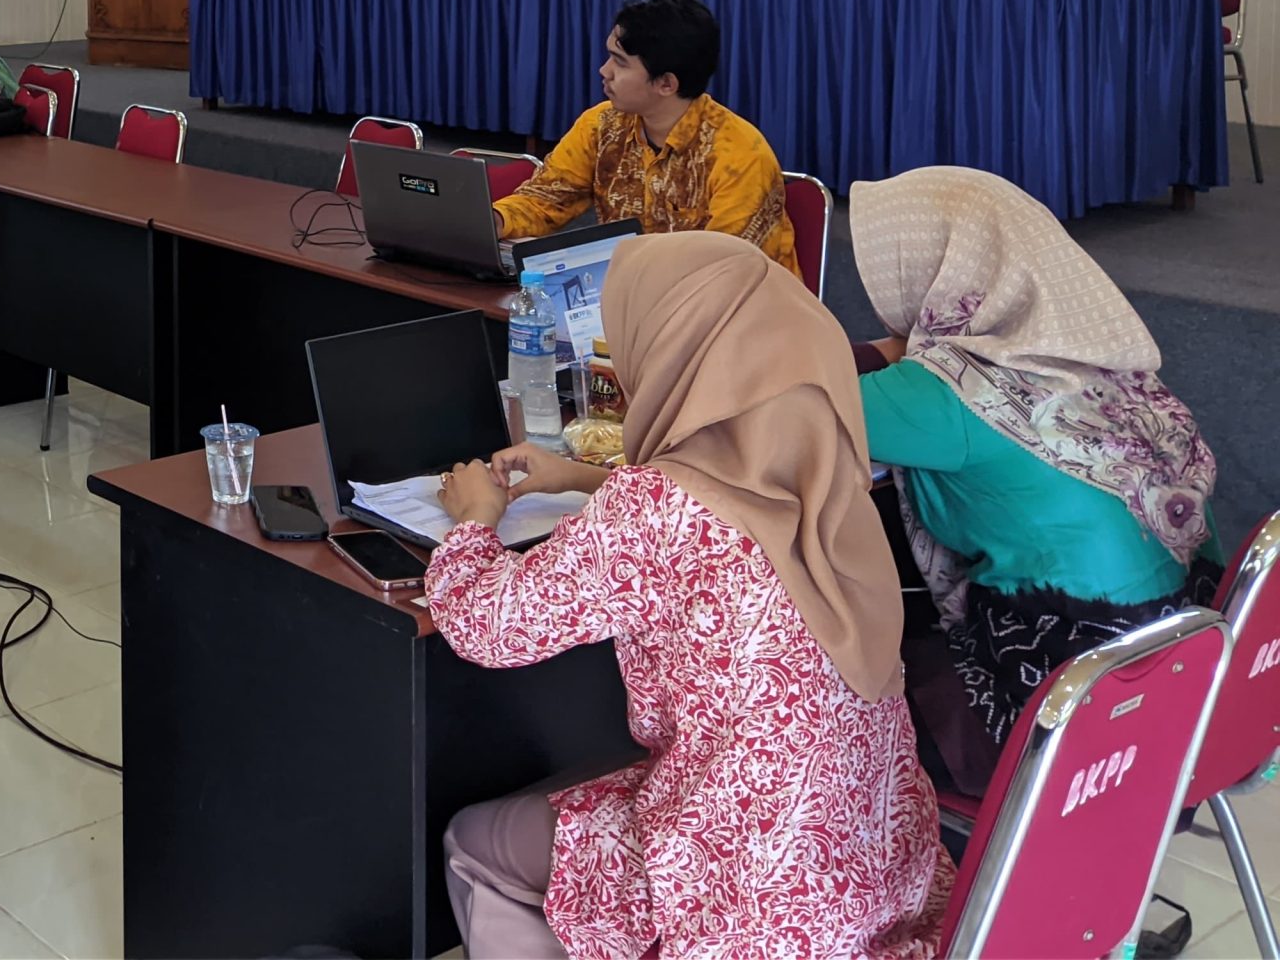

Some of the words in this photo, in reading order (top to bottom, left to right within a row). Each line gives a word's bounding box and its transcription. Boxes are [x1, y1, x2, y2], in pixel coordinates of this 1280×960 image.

[591, 382, 618, 395] OLDA
[1248, 638, 1280, 679] BK
[1061, 744, 1138, 817] BKPP
